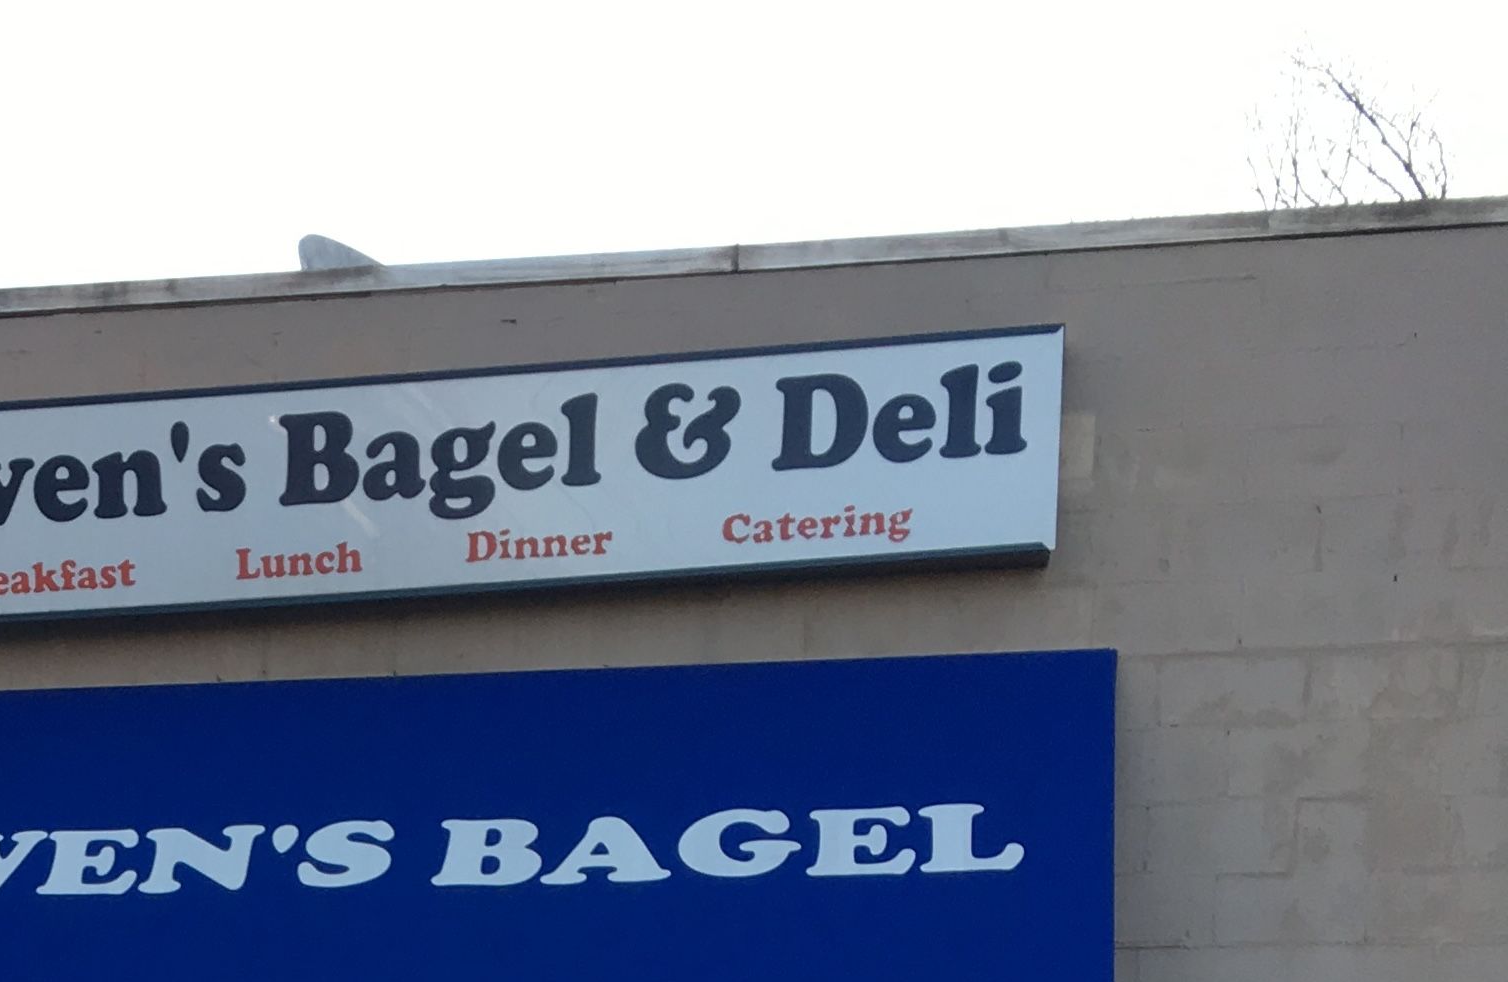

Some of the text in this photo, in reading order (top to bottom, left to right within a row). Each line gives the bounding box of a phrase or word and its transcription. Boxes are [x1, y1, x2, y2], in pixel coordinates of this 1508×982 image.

[278, 392, 601, 519] Bagel
[635, 383, 741, 479] &
[771, 361, 1027, 471] Deli
[235, 542, 362, 580] Lunch
[465, 529, 612, 563] Dinner
[722, 505, 913, 544] Catering
[430, 803, 1025, 886] BAGEL
